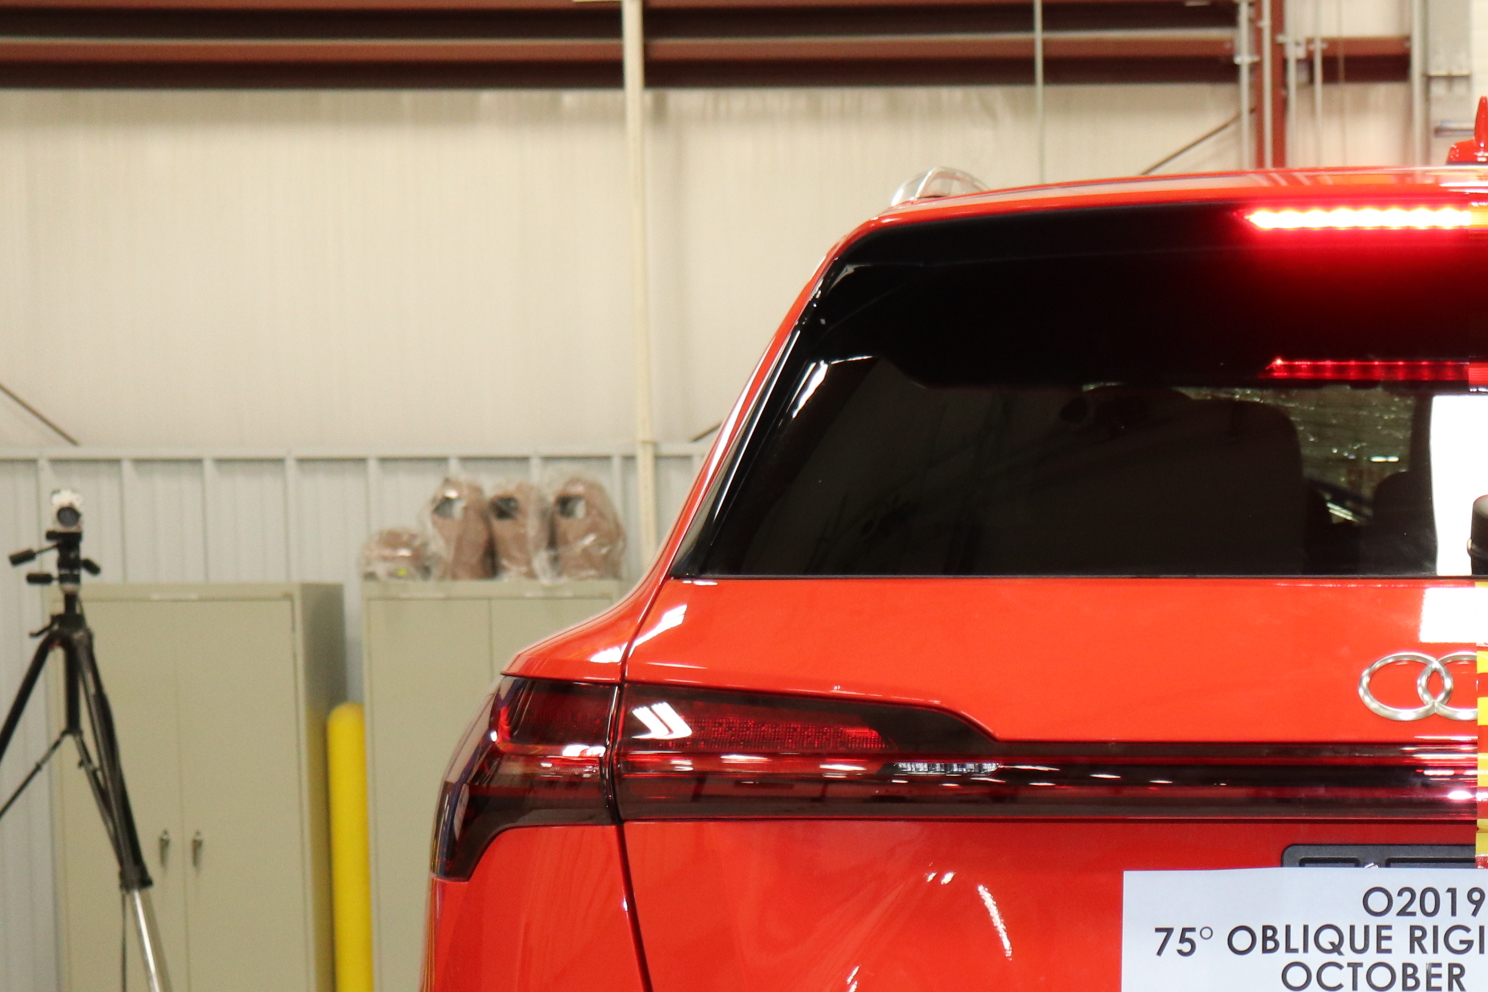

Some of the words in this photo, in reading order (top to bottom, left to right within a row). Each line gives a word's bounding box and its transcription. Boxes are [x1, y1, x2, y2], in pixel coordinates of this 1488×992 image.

[1154, 926, 1214, 957] 75°
[1227, 923, 1393, 956] OBLIQUE
[1281, 961, 1466, 992] OCTOBER
